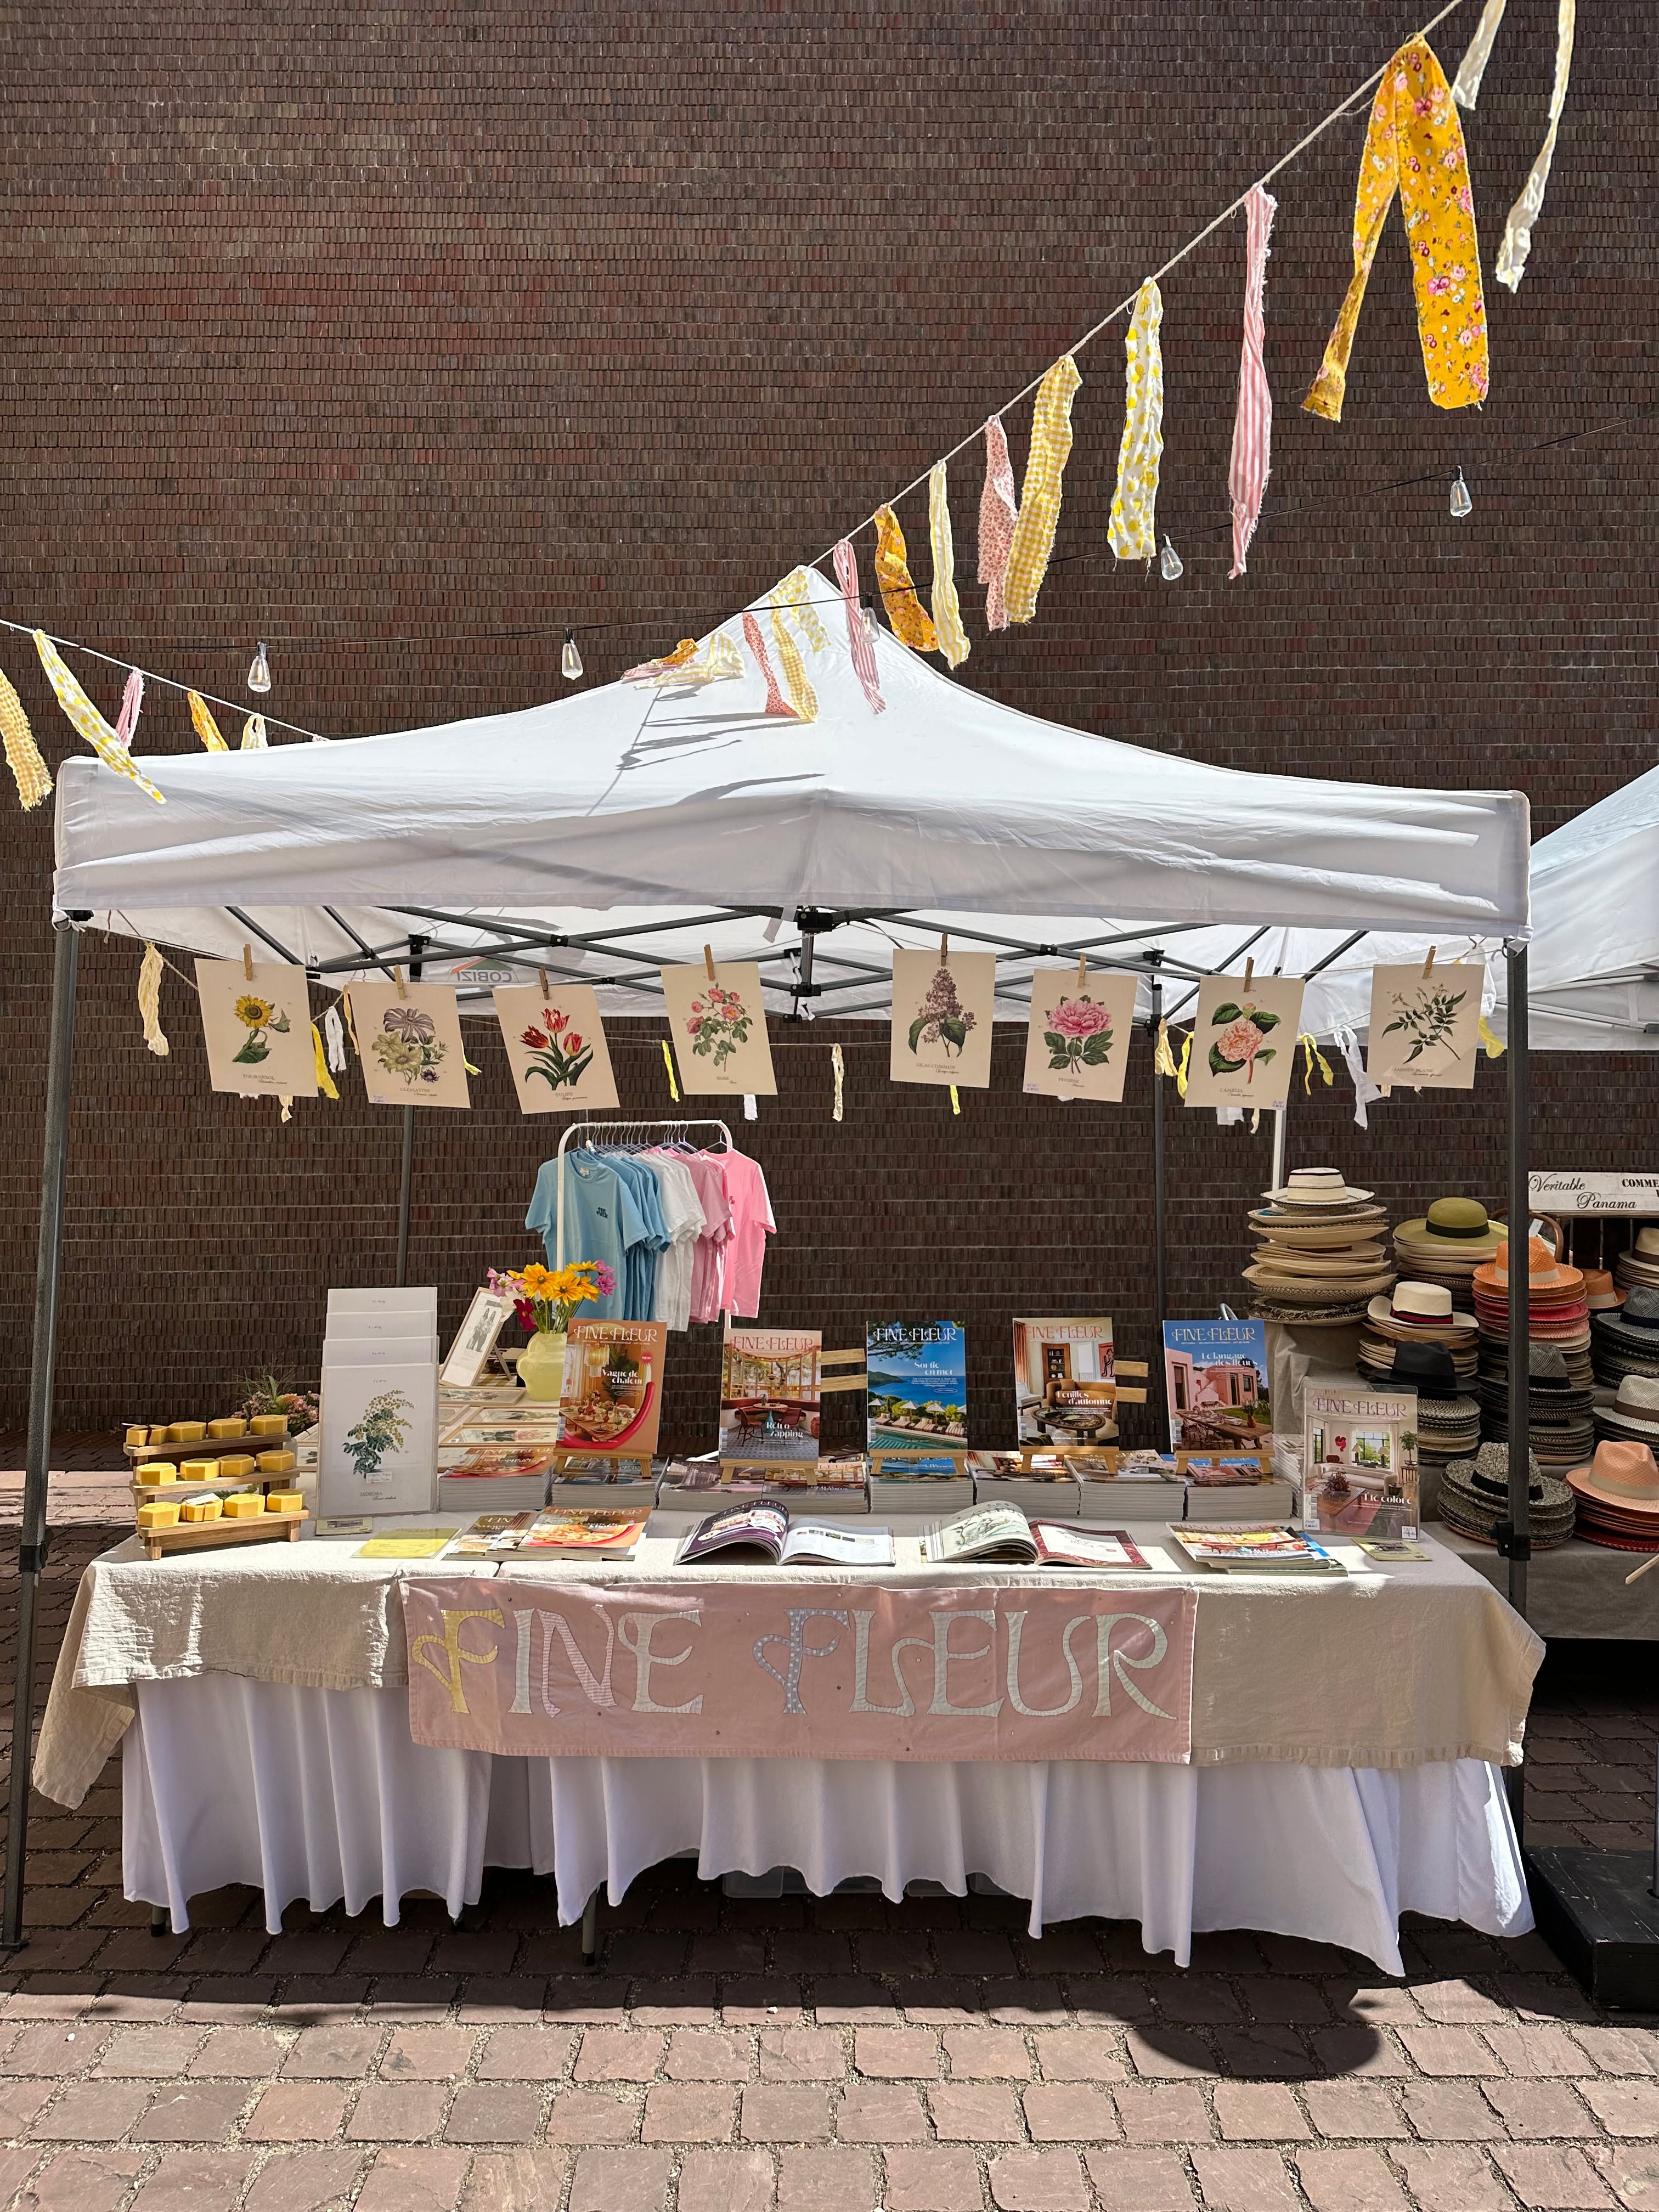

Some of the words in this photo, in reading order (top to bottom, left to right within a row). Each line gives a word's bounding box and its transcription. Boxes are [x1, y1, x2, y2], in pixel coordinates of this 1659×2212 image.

[1529, 1173, 1585, 1192] Veritable
[1622, 1178, 1659, 1188] COMME
[1577, 1192, 1637, 1209] Panama
[573, 1325, 608, 1340] FINE
[610, 1327, 658, 1342] FLEUR
[873, 1328, 908, 1341] FINE
[909, 1328, 957, 1341] FLEUR
[1025, 1325, 1054, 1339] FINE
[1056, 1325, 1105, 1339] FLEUR
[1171, 1328, 1206, 1341] FINE
[1207, 1328, 1257, 1341] FLEUR
[730, 1336, 764, 1350] FINE
[766, 1337, 813, 1351] FLEUR
[1213, 1352, 1246, 1360] langage
[602, 1369, 627, 1378] Vague
[1313, 1398, 1352, 1413] FINE
[1353, 1401, 1407, 1417] FLEUR
[770, 1430, 803, 1438] Zapping
[411, 1605, 704, 1718] FINE
[753, 1607, 1177, 1719] FLEUR
